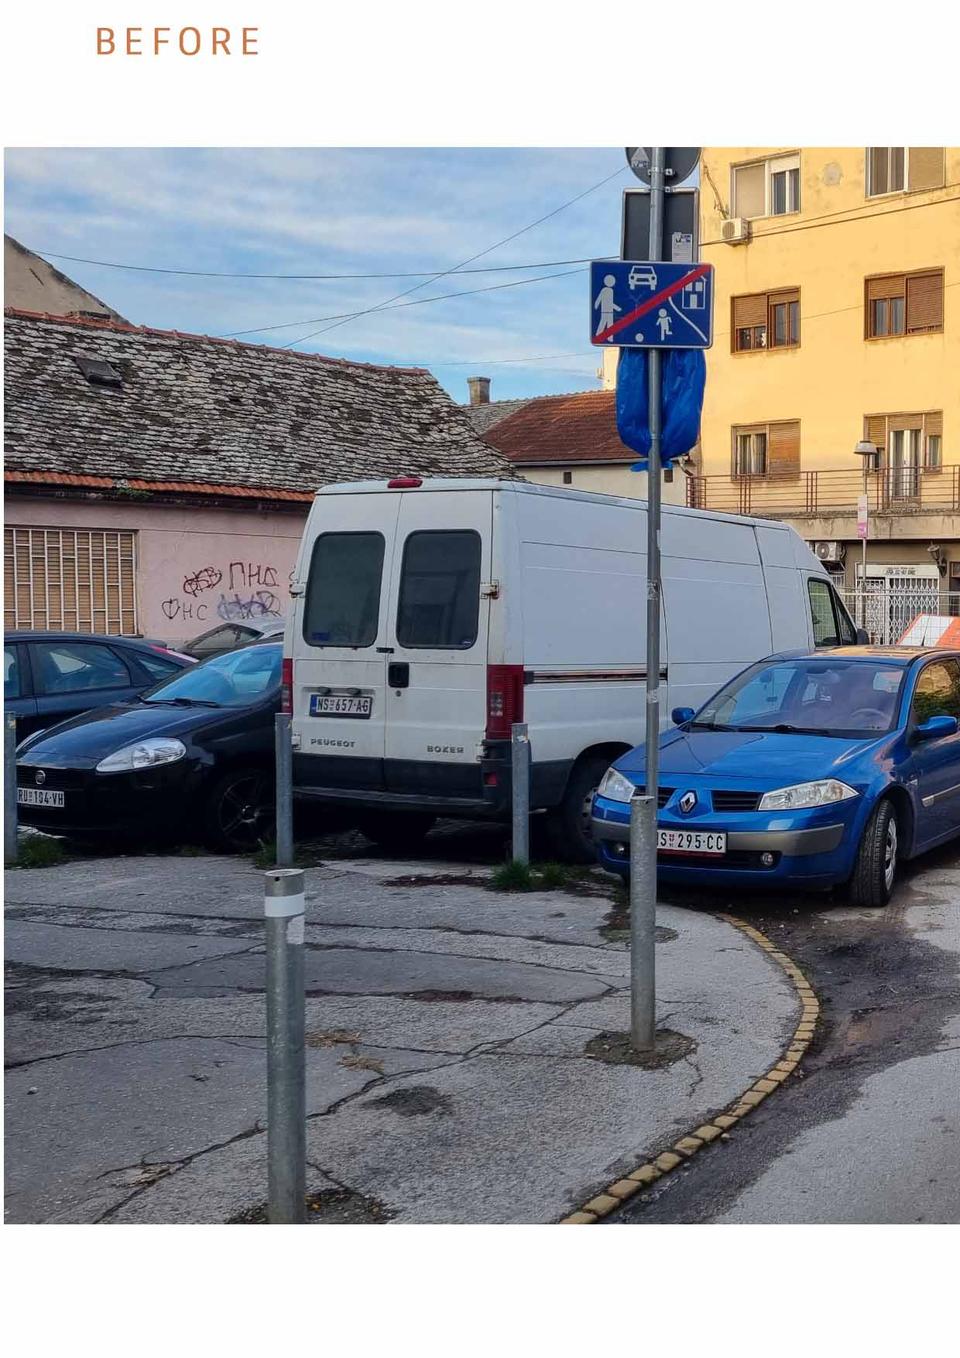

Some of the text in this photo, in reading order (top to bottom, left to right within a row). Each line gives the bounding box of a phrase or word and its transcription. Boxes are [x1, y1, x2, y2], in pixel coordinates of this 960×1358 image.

[317, 699, 329, 711] NS
[310, 738, 356, 749] PEUGEOT
[427, 745, 464, 754] BOXER
